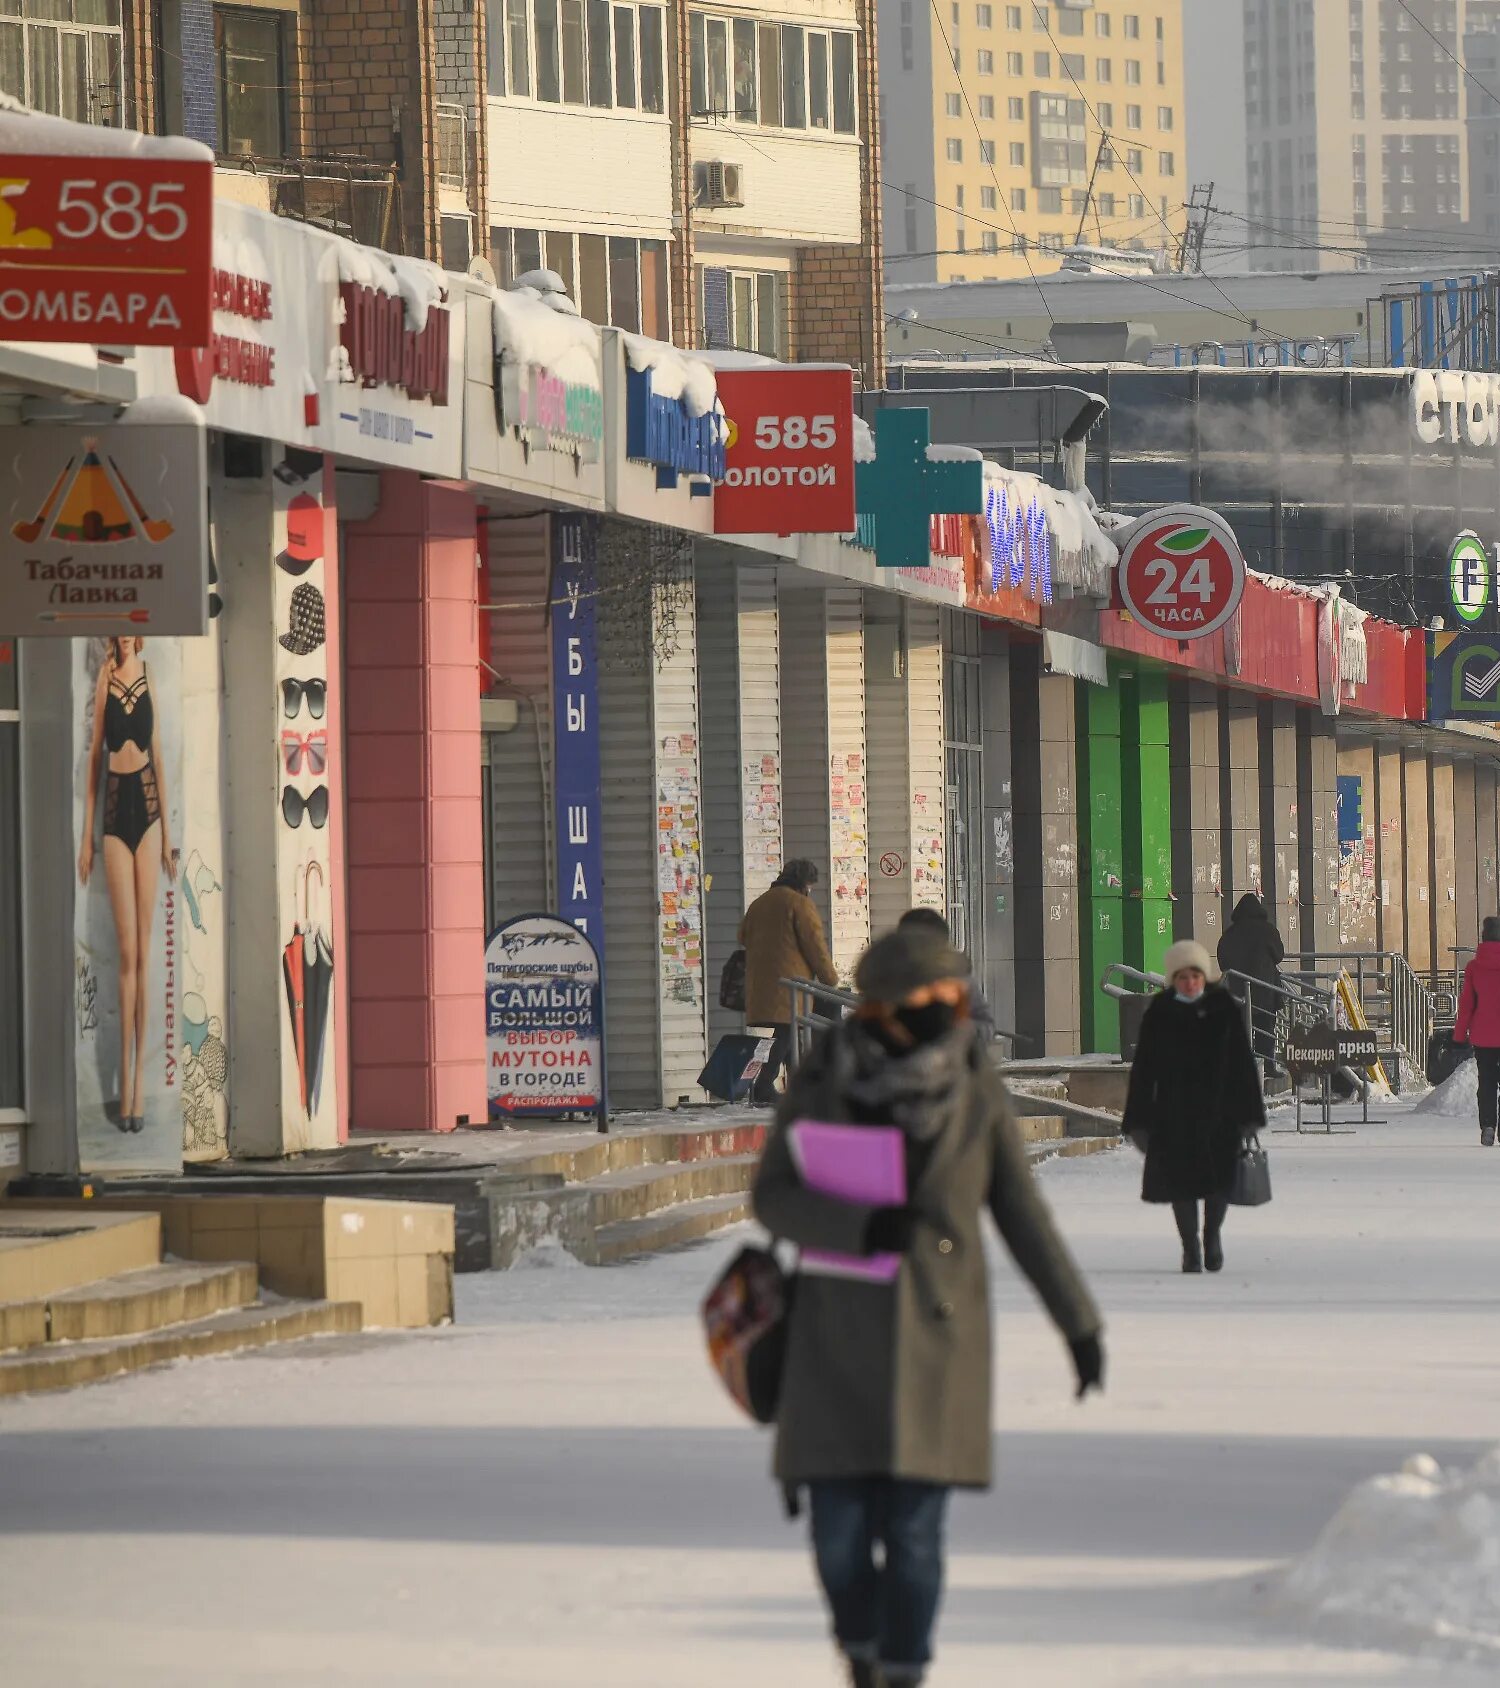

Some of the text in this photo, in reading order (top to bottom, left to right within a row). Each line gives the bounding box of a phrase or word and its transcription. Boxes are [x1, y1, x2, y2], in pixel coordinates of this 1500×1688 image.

[56, 179, 188, 241] 585
[754, 415, 837, 449] 585
[714, 464, 837, 487] ОЛОТОЙ
[24, 557, 164, 581] Табачная
[1144, 558, 1216, 604] 24
[48, 582, 138, 604] Лавка
[1154, 607, 1205, 622] ЧАСА
[487, 962, 593, 974] Пятигорские шубы
[490, 984, 593, 1008] САМЫЙ
[490, 1008, 593, 1026] БОЛЬШОЙ
[506, 1030, 577, 1045] ВЫБОР
[491, 1050, 593, 1067] МУТОНА
[1286, 1044, 1335, 1066] Пекарня
[500, 1072, 586, 1087] В ГОРОДЕ
[507, 1096, 580, 1106] РАСПРОДАЖА
